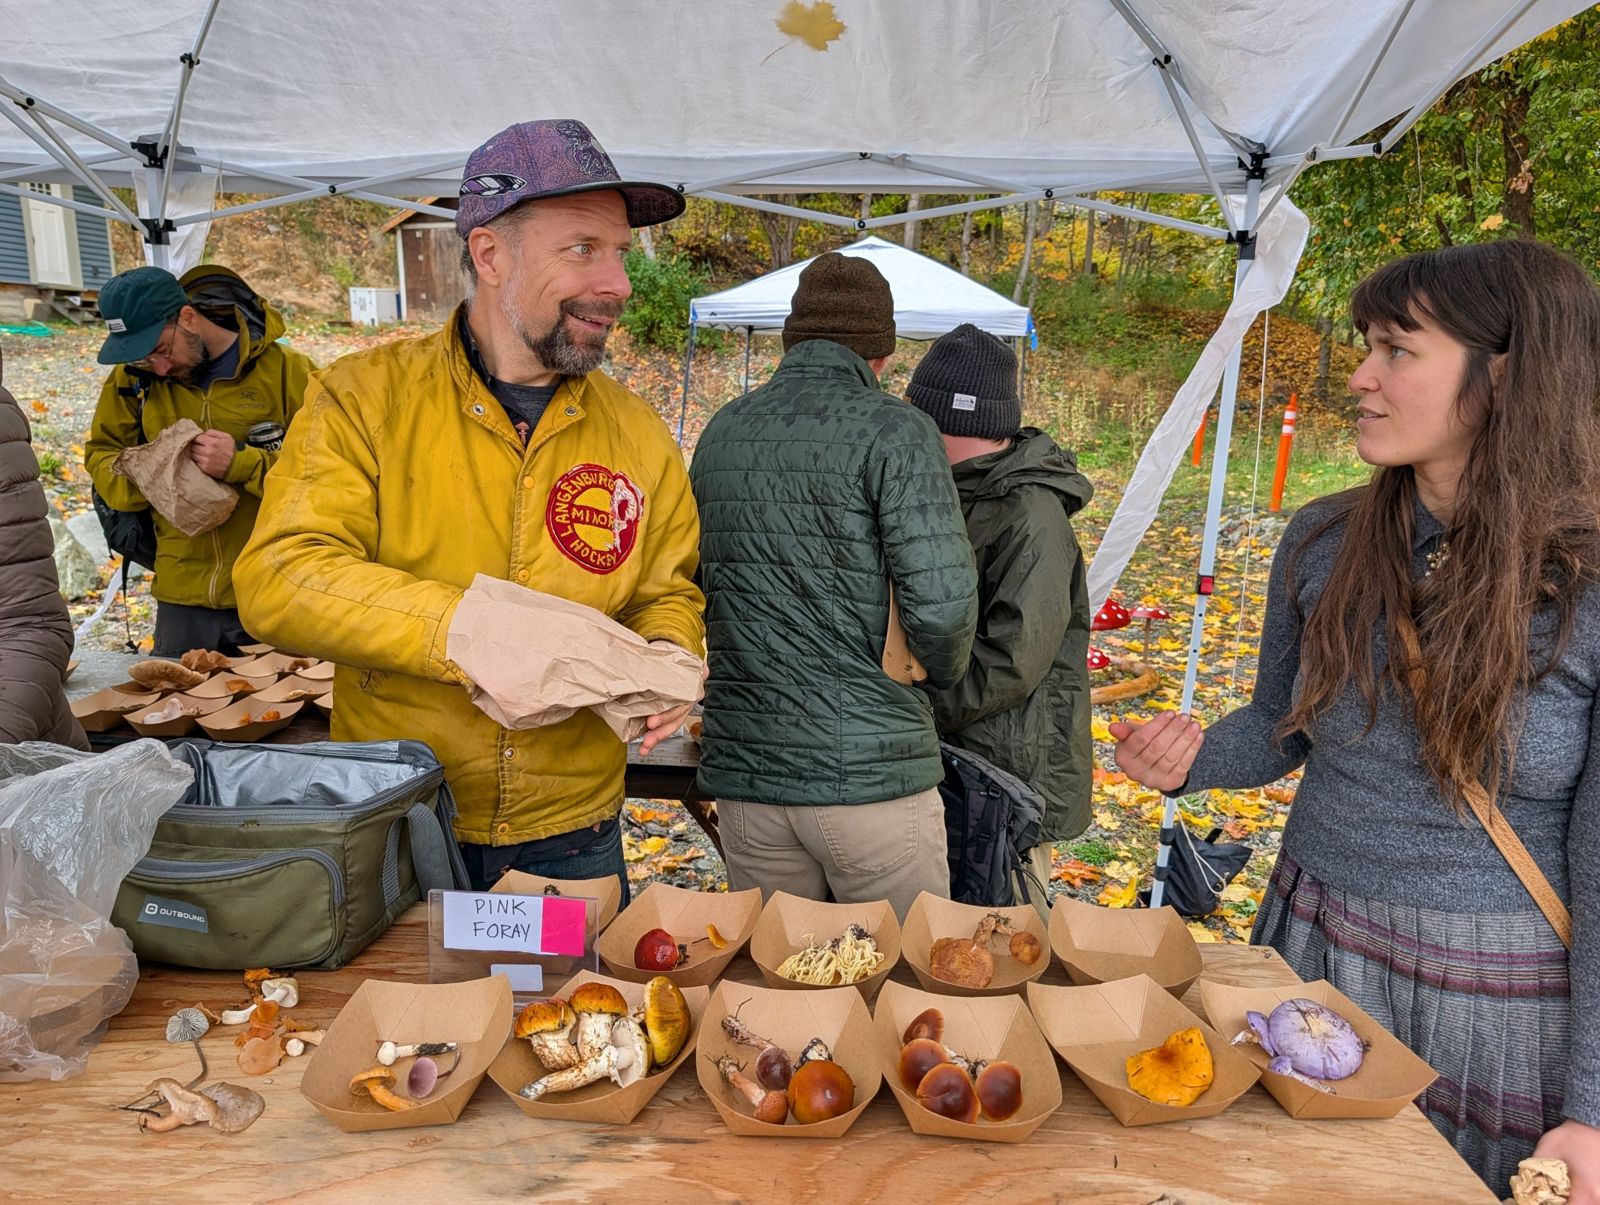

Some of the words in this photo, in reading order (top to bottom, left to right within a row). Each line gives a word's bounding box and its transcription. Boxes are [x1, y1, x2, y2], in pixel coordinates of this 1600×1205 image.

[555, 472, 616, 538] LANGENBURG
[571, 506, 614, 530] MINOR
[570, 539, 616, 566] HOCKEY
[160, 908, 205, 923] OUTBOUND
[474, 898, 527, 916] PINK
[473, 921, 531, 942] FORAY
